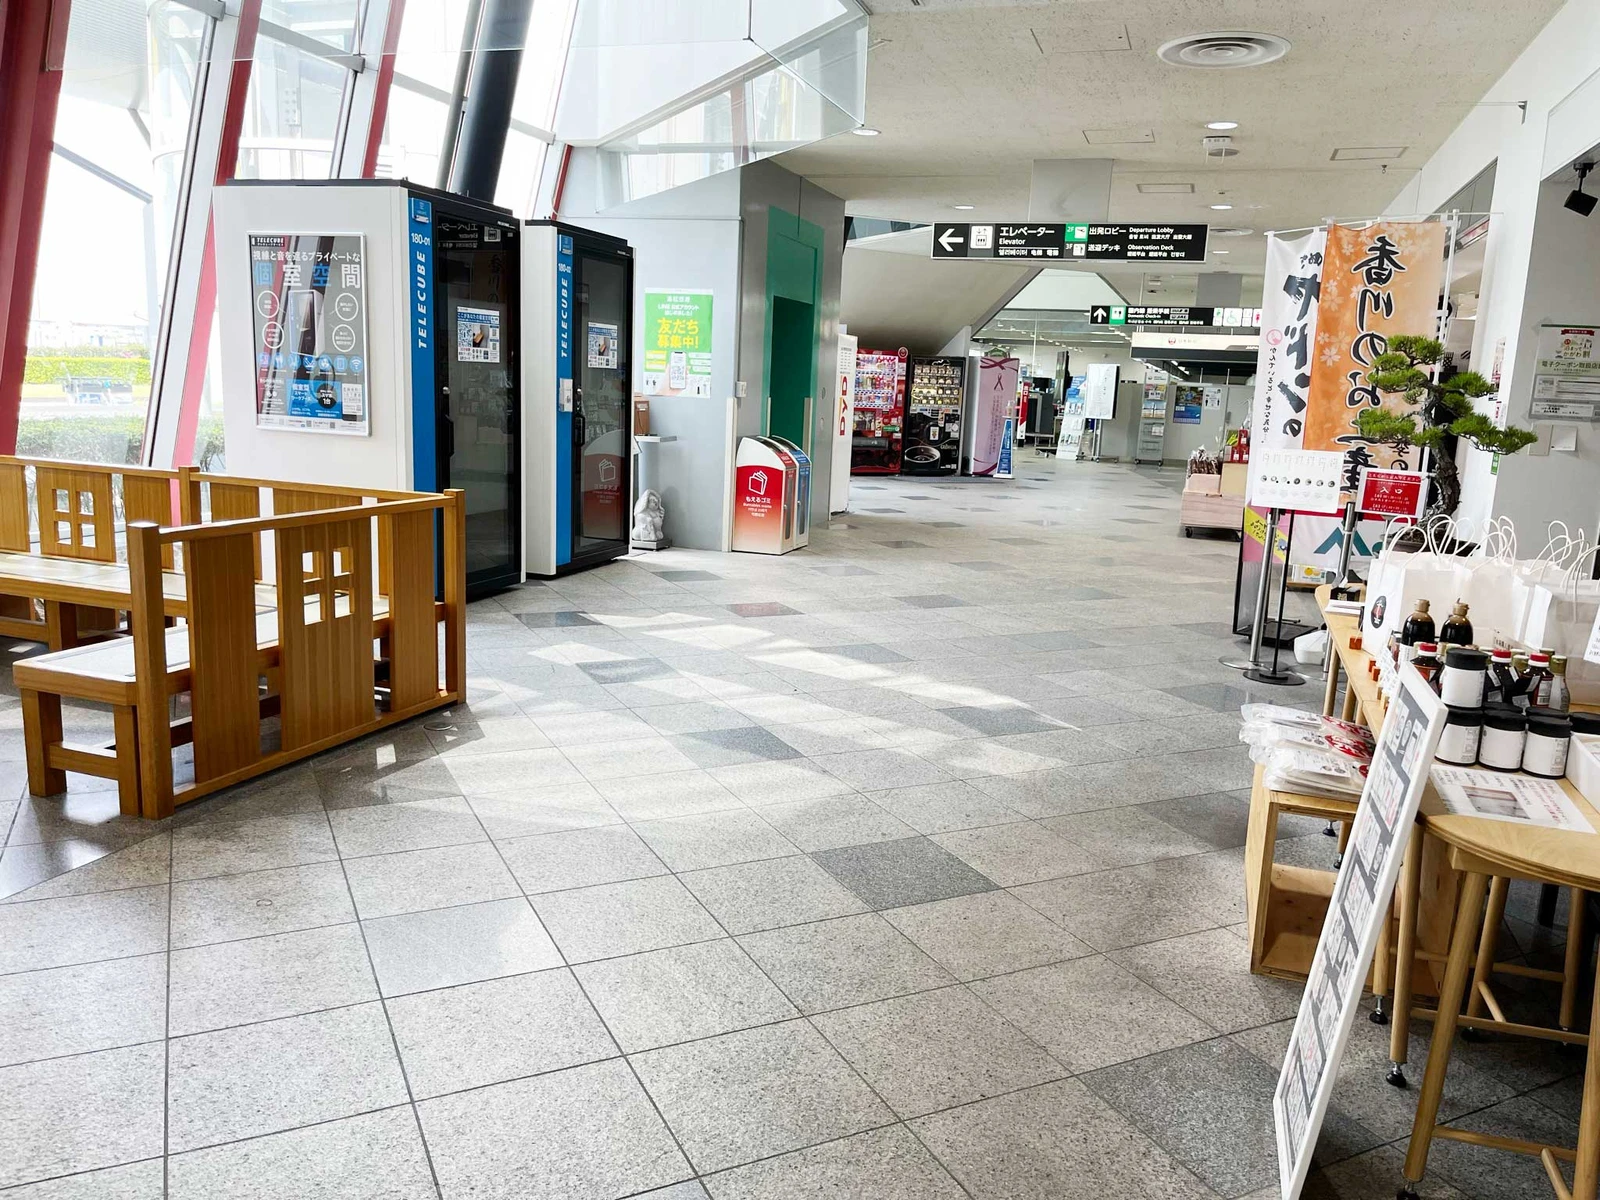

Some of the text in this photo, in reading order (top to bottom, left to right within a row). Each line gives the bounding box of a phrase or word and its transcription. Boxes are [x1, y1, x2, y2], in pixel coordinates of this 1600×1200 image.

[999, 226, 1055, 237] エレベーター
[1089, 226, 1127, 235] 出発ロビー
[411, 233, 430, 246] 180-01
[1087, 243, 1121, 252] 送迎デッキ
[416, 250, 428, 349] TELECUBE
[561, 278, 569, 358] TELECUBE
[657, 317, 699, 335] 友だち
[657, 334, 699, 349] 募集中!
[1380, 486, 1403, 495] 入口
[745, 496, 771, 504] もえるゴミ
